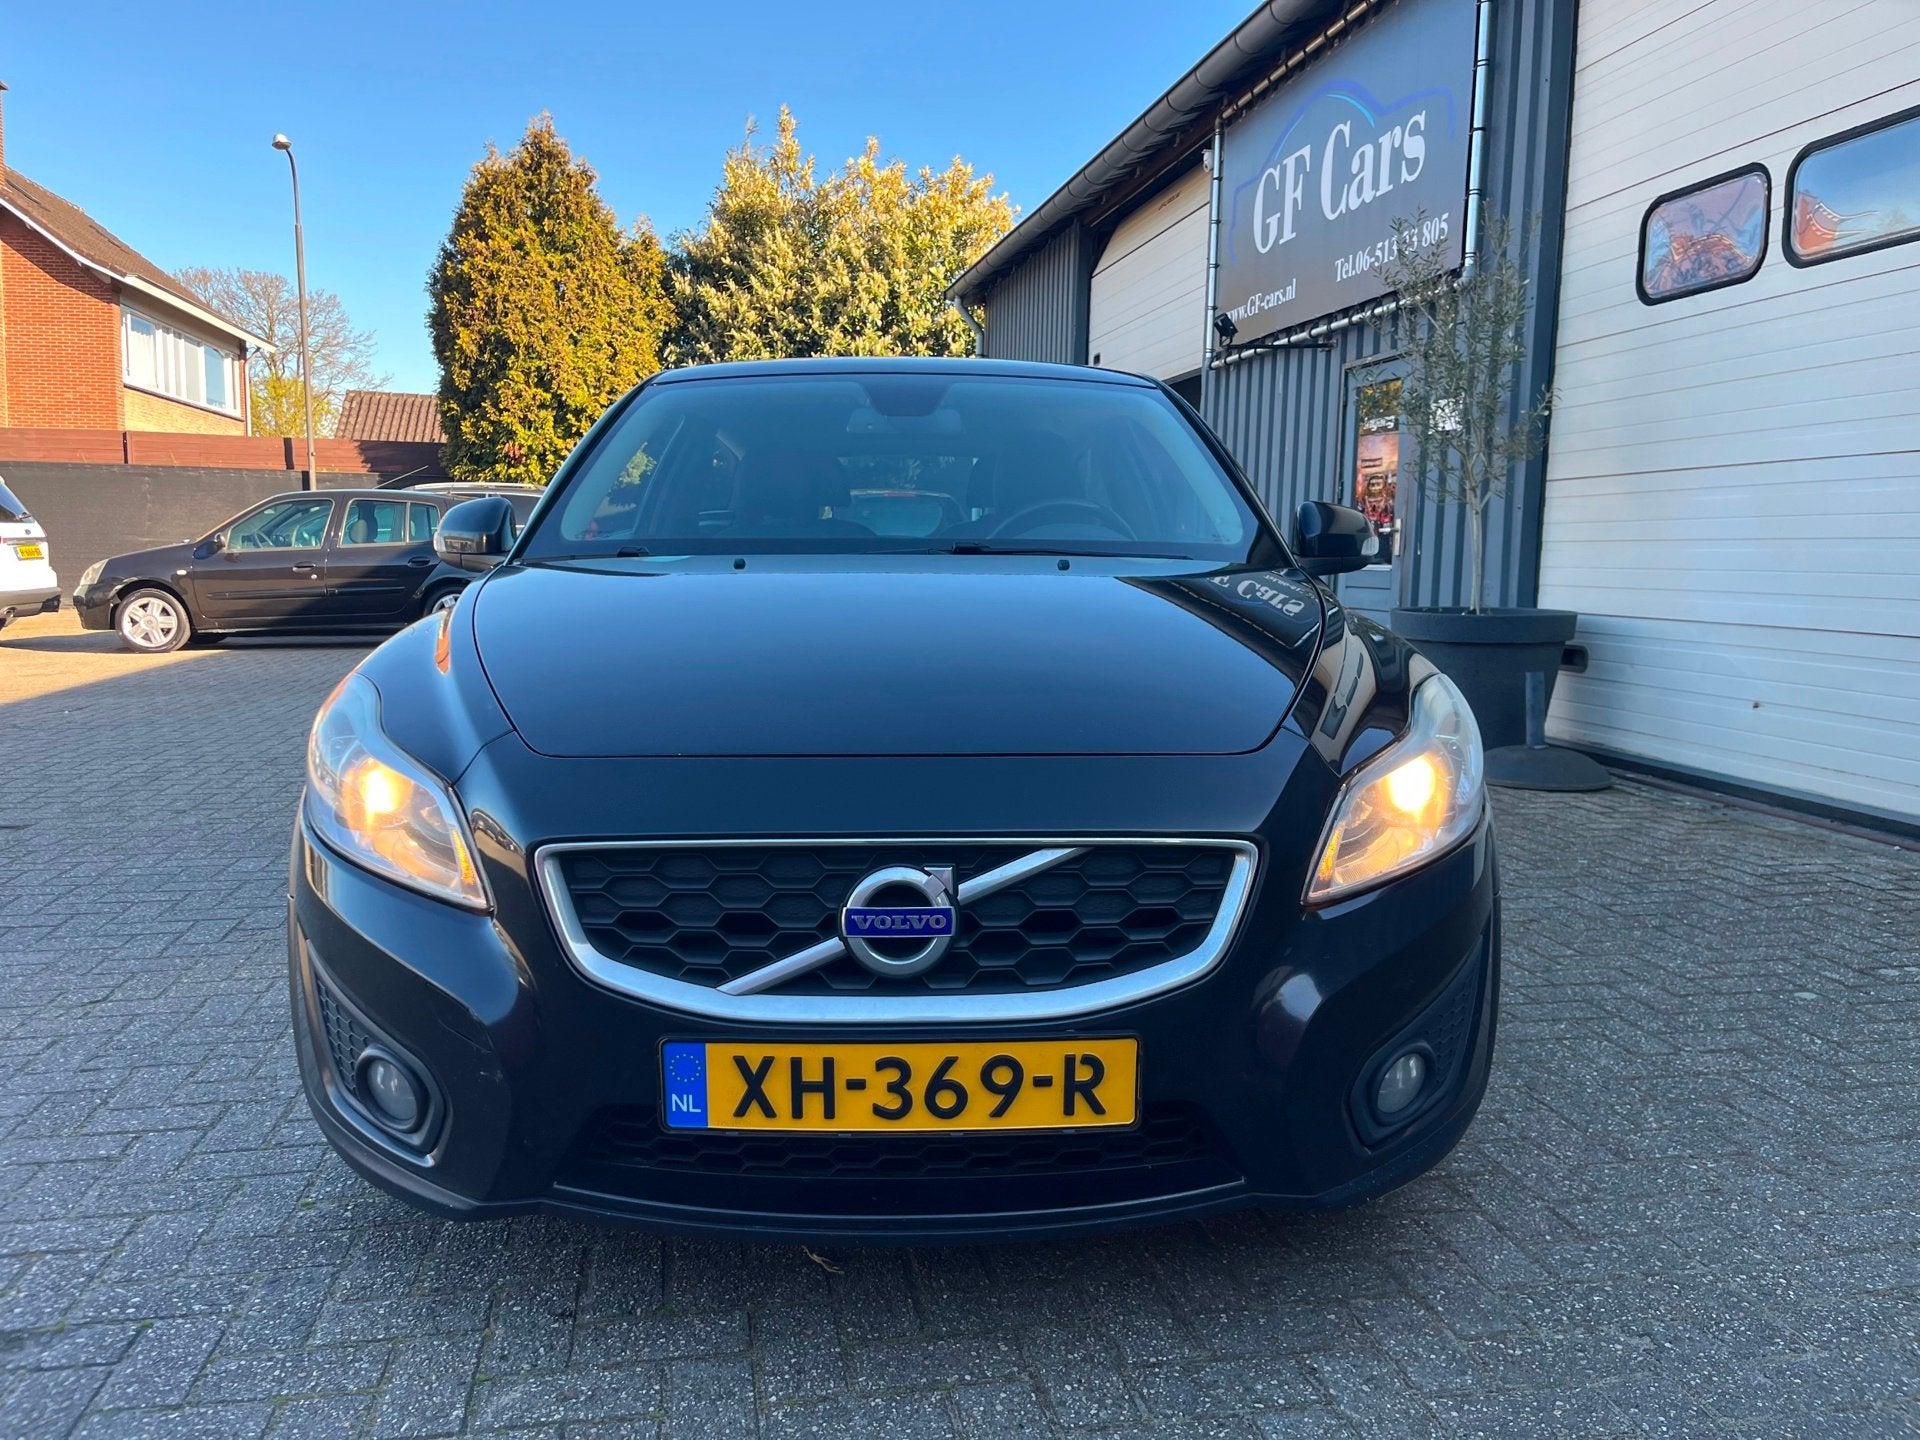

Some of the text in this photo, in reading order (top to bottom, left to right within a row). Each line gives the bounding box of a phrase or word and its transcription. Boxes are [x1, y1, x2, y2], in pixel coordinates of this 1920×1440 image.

[1253, 110, 1427, 254] GF Cars
[1421, 212, 1450, 248] 805
[851, 914, 947, 930] VOLVO
[671, 1093, 702, 1113] NL
[732, 1053, 1107, 1120] XH-369-R
